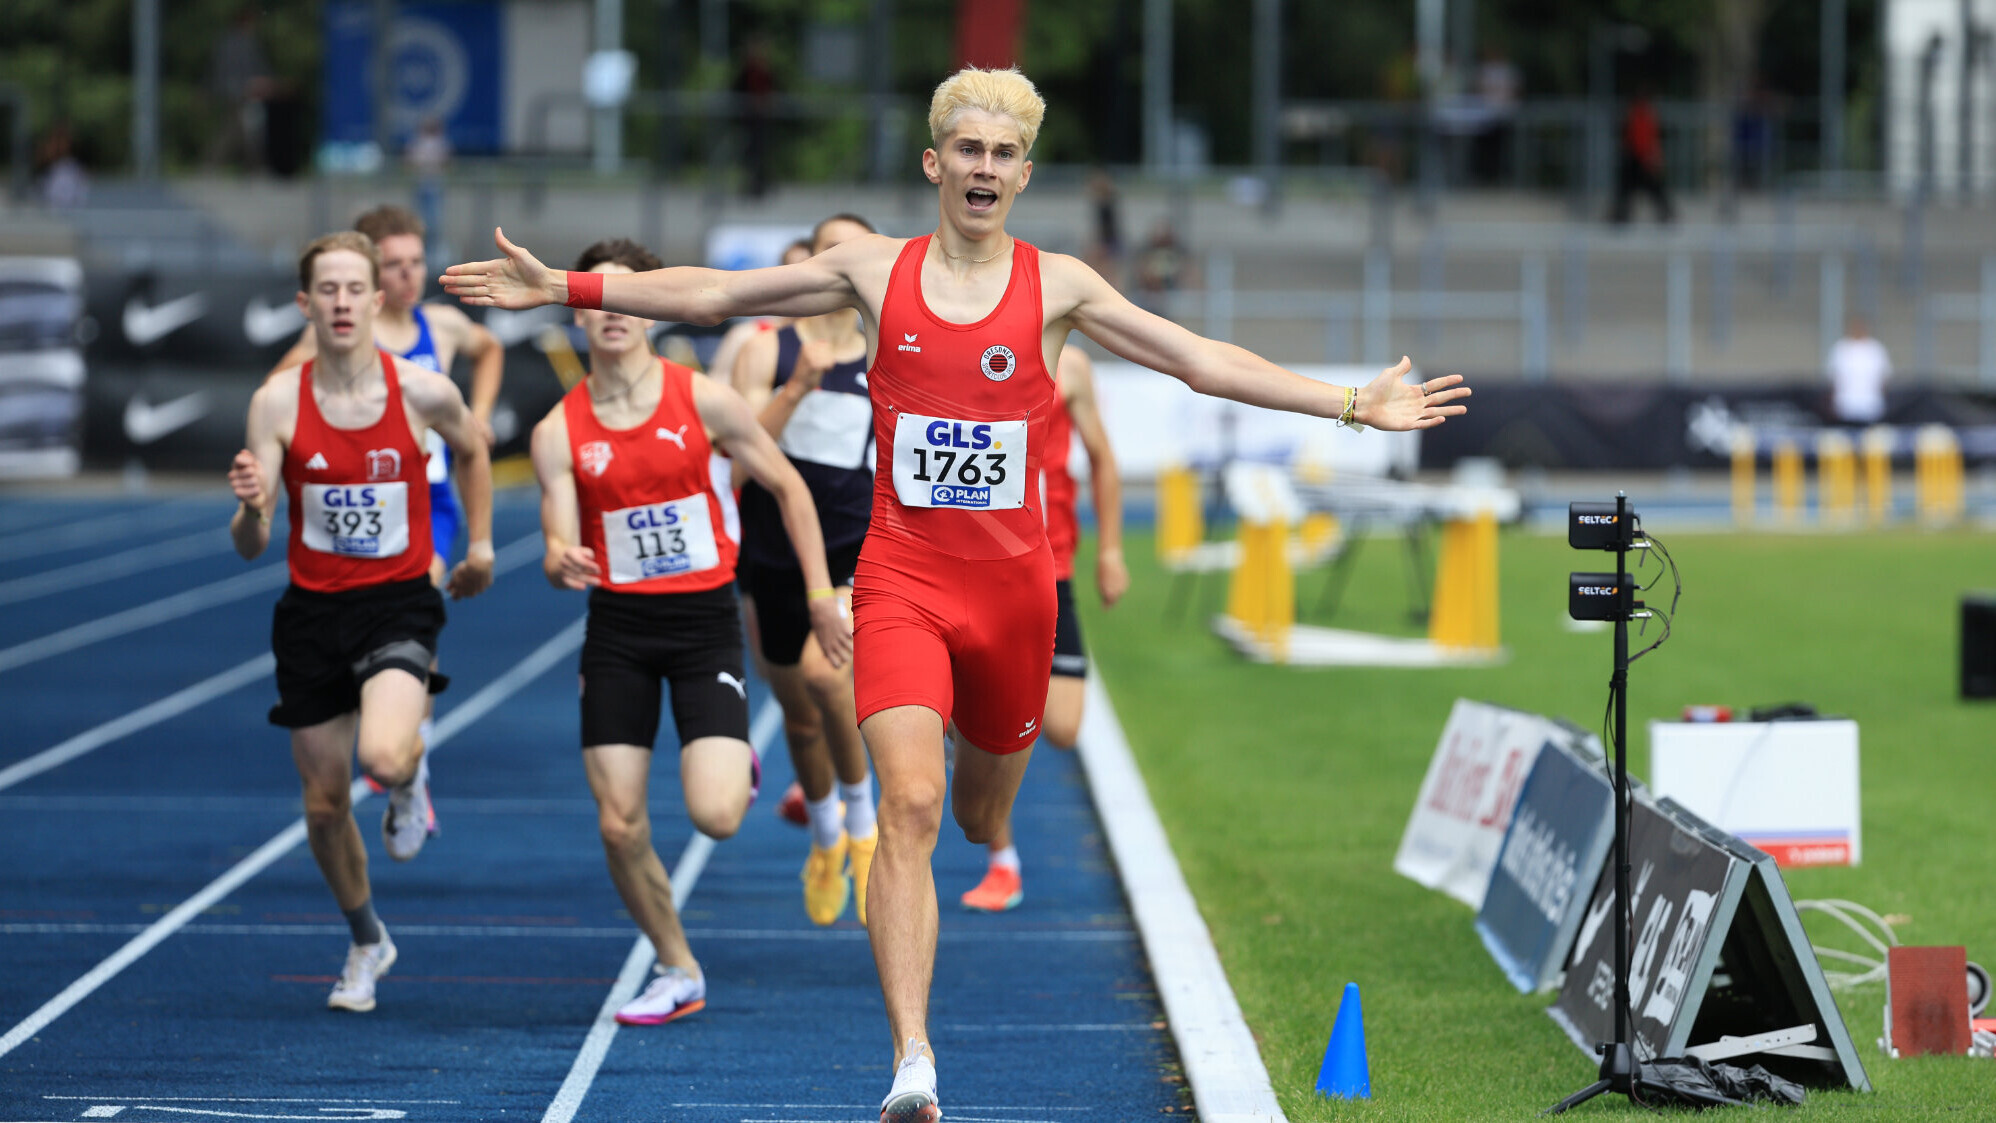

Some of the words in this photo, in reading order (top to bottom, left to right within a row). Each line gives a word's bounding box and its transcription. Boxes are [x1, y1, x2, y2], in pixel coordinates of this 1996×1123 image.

[898, 344, 921, 353] erima
[983, 346, 1013, 360] DRESDNER
[913, 448, 1007, 486] 1763
[956, 489, 988, 500] PLAN
[322, 509, 383, 537] 393
[1578, 515, 1612, 525] SELTEC
[632, 528, 686, 560] 113
[1578, 586, 1612, 596] SELTEC
